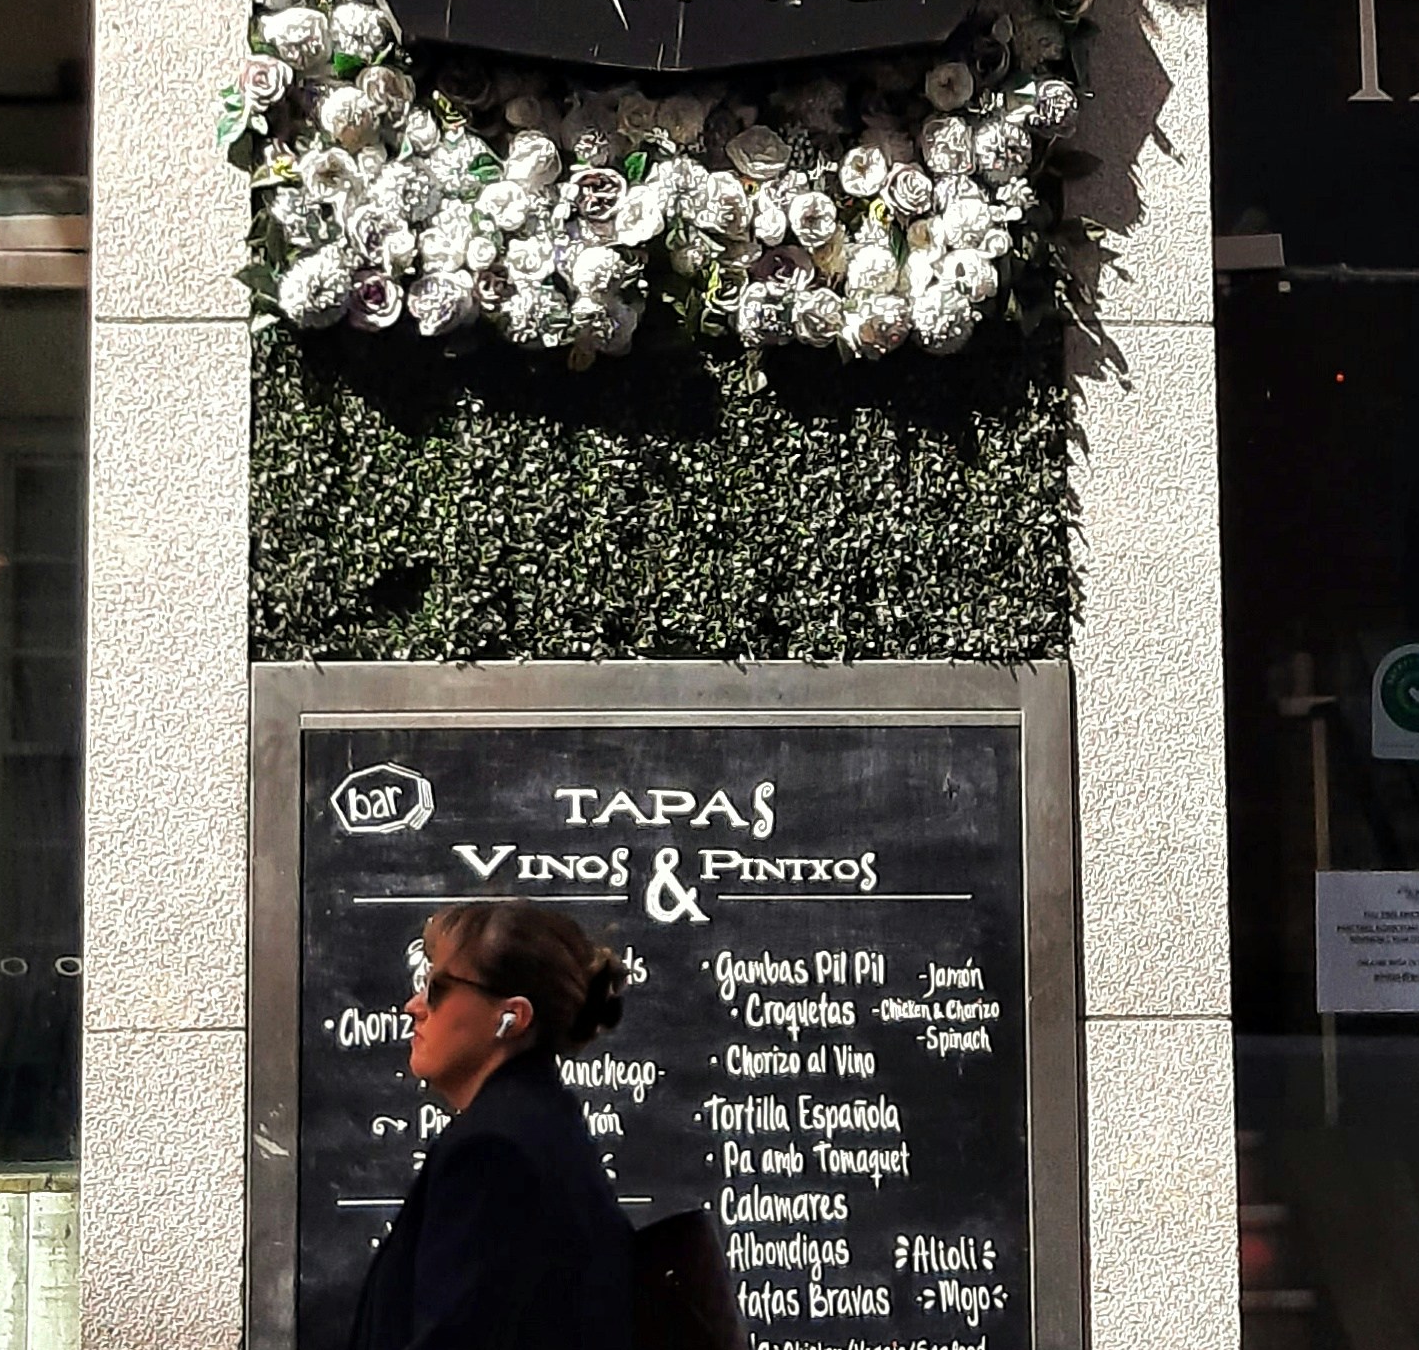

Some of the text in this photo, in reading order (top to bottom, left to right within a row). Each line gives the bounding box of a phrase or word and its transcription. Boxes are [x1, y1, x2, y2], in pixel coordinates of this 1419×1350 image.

[348, 784, 403, 822] bar
[555, 781, 776, 839] TAPAS
[452, 844, 877, 924] VINOS & PINTXOS
[815, 951, 848, 985] Pil
[854, 951, 885, 986] Pil
[340, 1006, 416, 1047] Choriz
[745, 992, 856, 1042] Croquetas
[945, 997, 1001, 1022] Chorizo
[727, 1044, 876, 1079] Chorizo al Vino
[704, 1094, 902, 1139] Tortilla Española
[724, 1140, 911, 1190] Pa amb Tomaquet
[720, 1183, 849, 1225] Calamares
[727, 1232, 979, 1282] Albondigas Alioli
[736, 1279, 991, 1328] tatas Bravas Mojo
